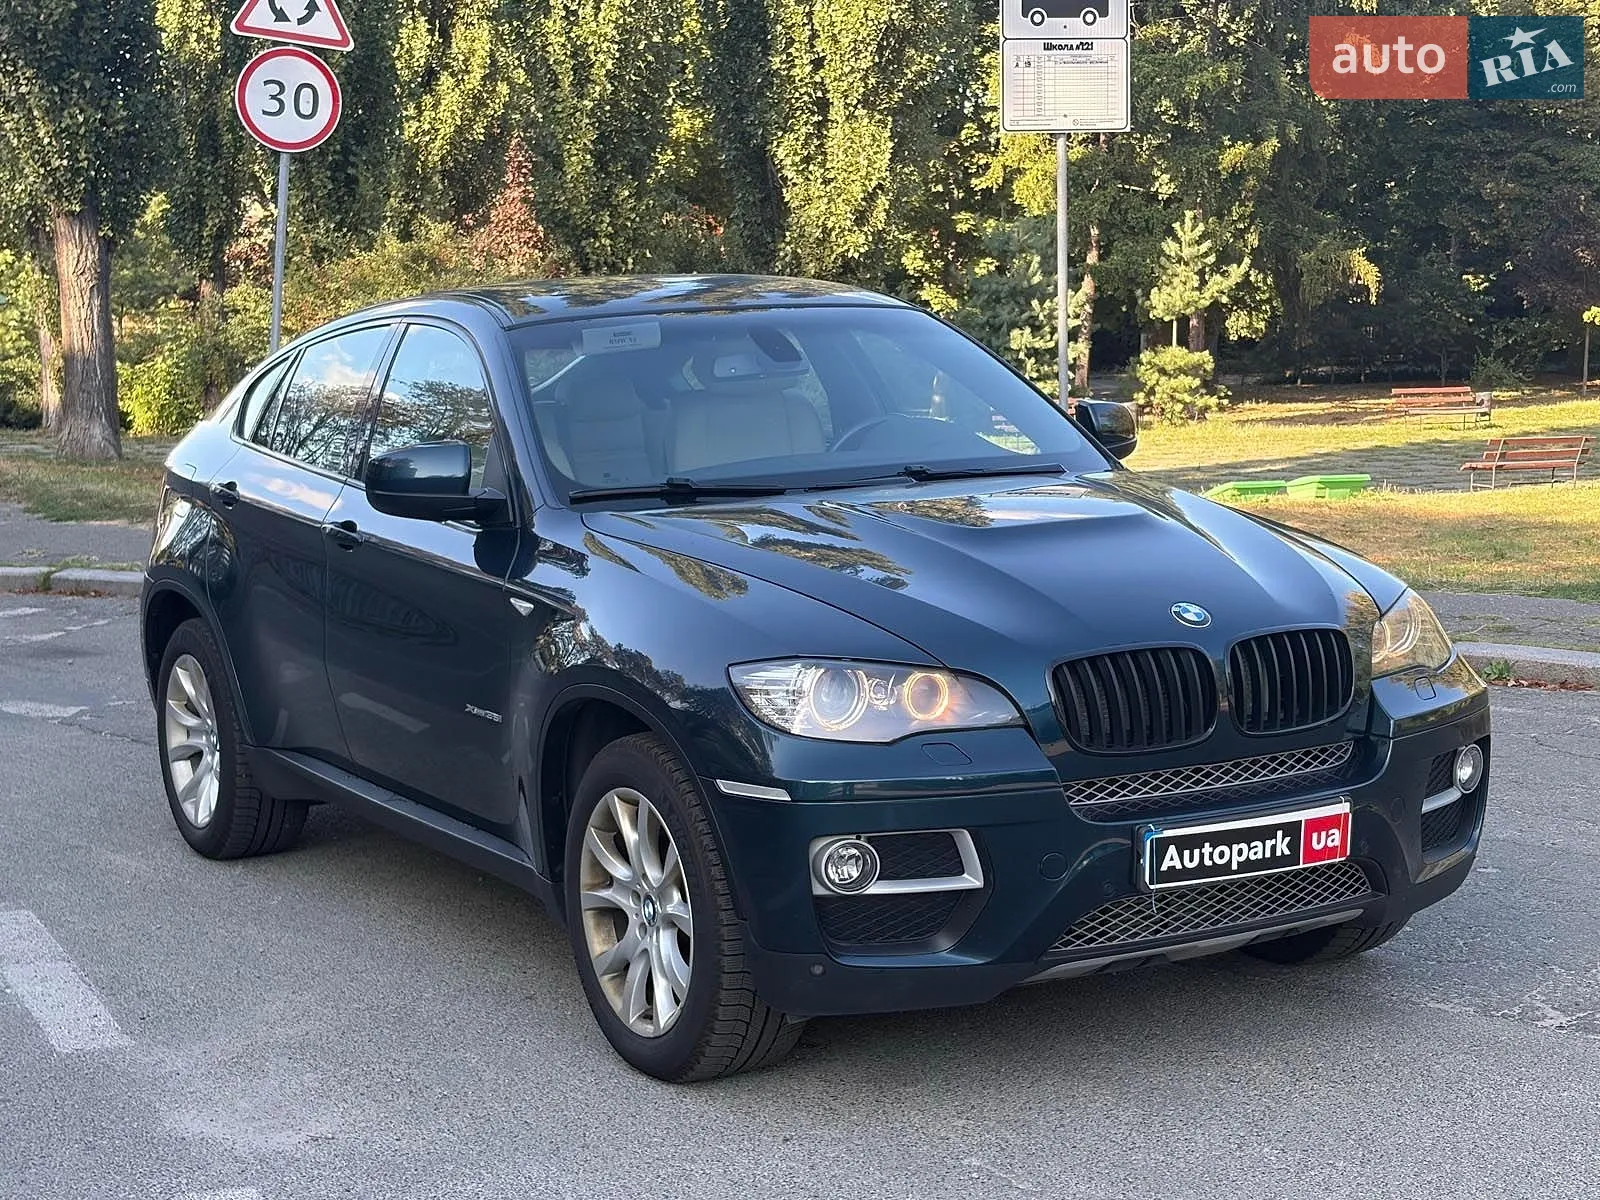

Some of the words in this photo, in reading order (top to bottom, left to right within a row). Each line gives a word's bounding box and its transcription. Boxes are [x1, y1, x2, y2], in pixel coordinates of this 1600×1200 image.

[1043, 41, 1074, 51] Школа
[261, 79, 320, 121] 30
[1160, 830, 1291, 871] Autopark
[1311, 828, 1341, 850] ua
